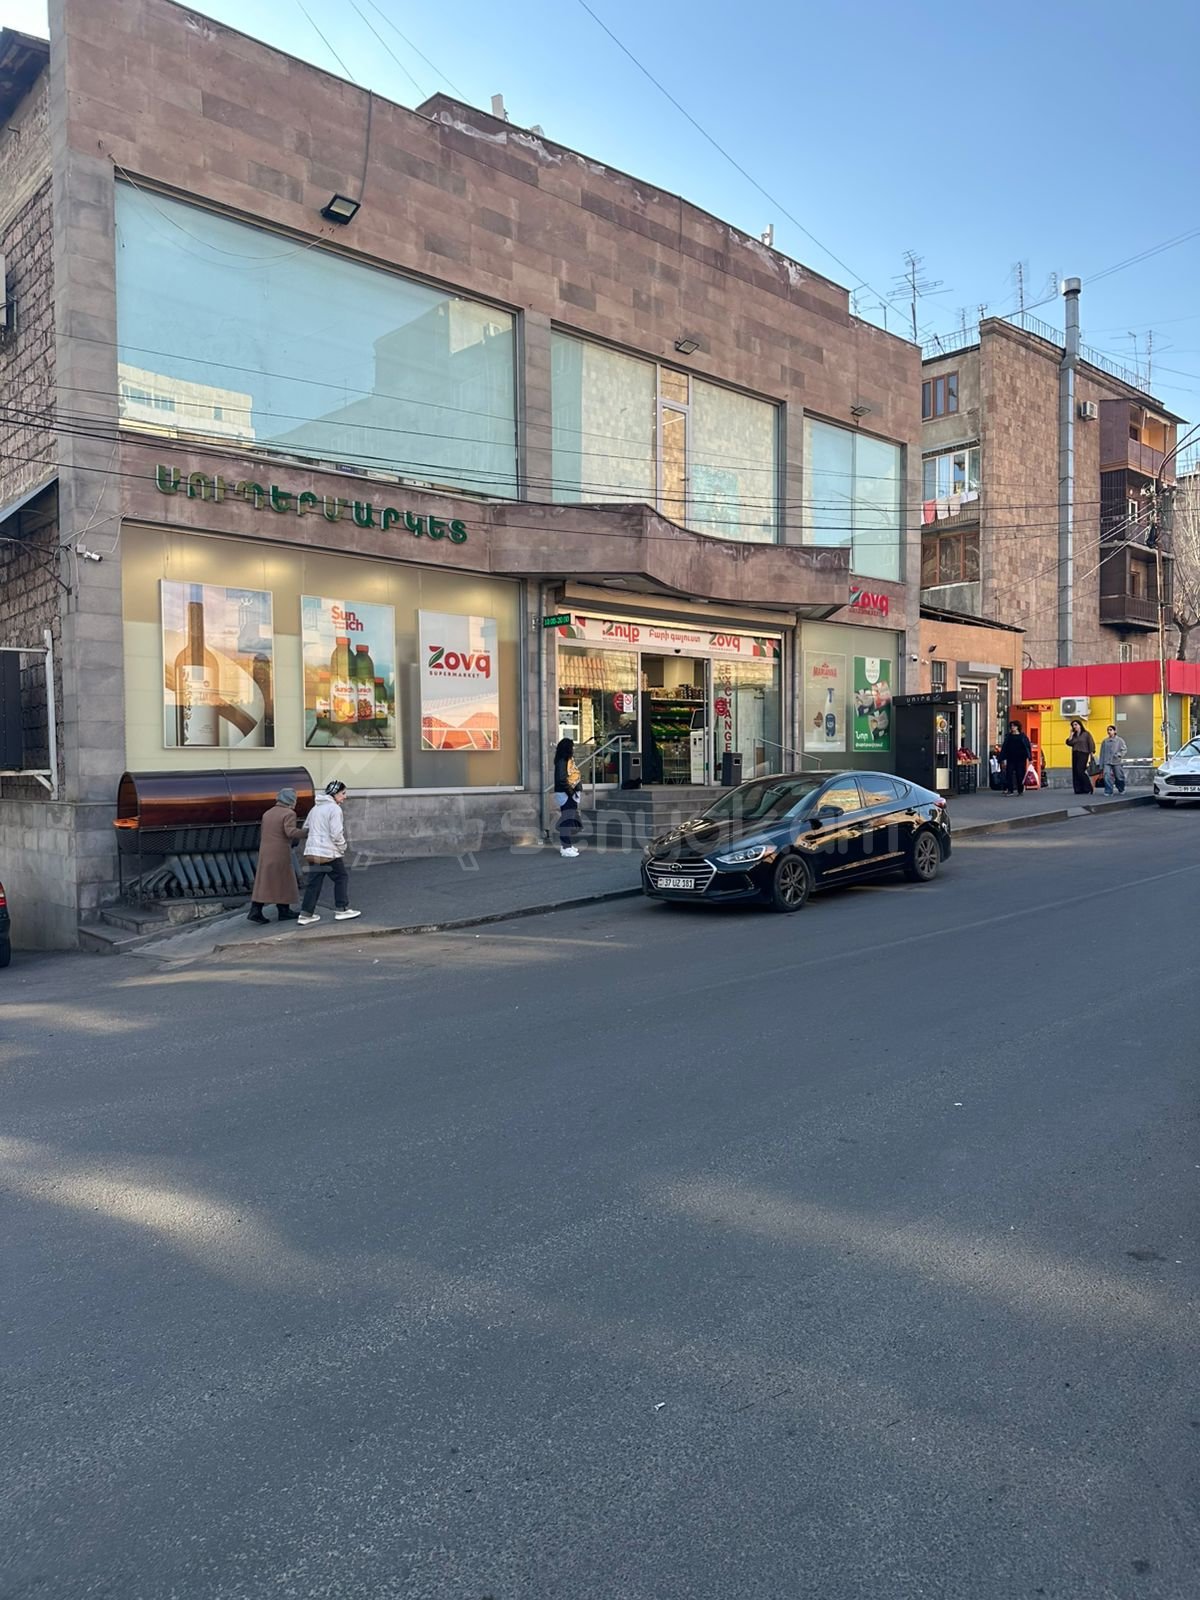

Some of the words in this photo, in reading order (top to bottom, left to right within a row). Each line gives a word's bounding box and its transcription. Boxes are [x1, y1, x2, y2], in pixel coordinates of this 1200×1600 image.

[849, 586, 888, 617] Zovq
[649, 628, 670, 641] Բարի
[670, 632, 700, 643] գալուստ
[709, 632, 740, 652] Zovq
[428, 646, 490, 678] Zovq
[724, 664, 732, 752] EXCHANGE
